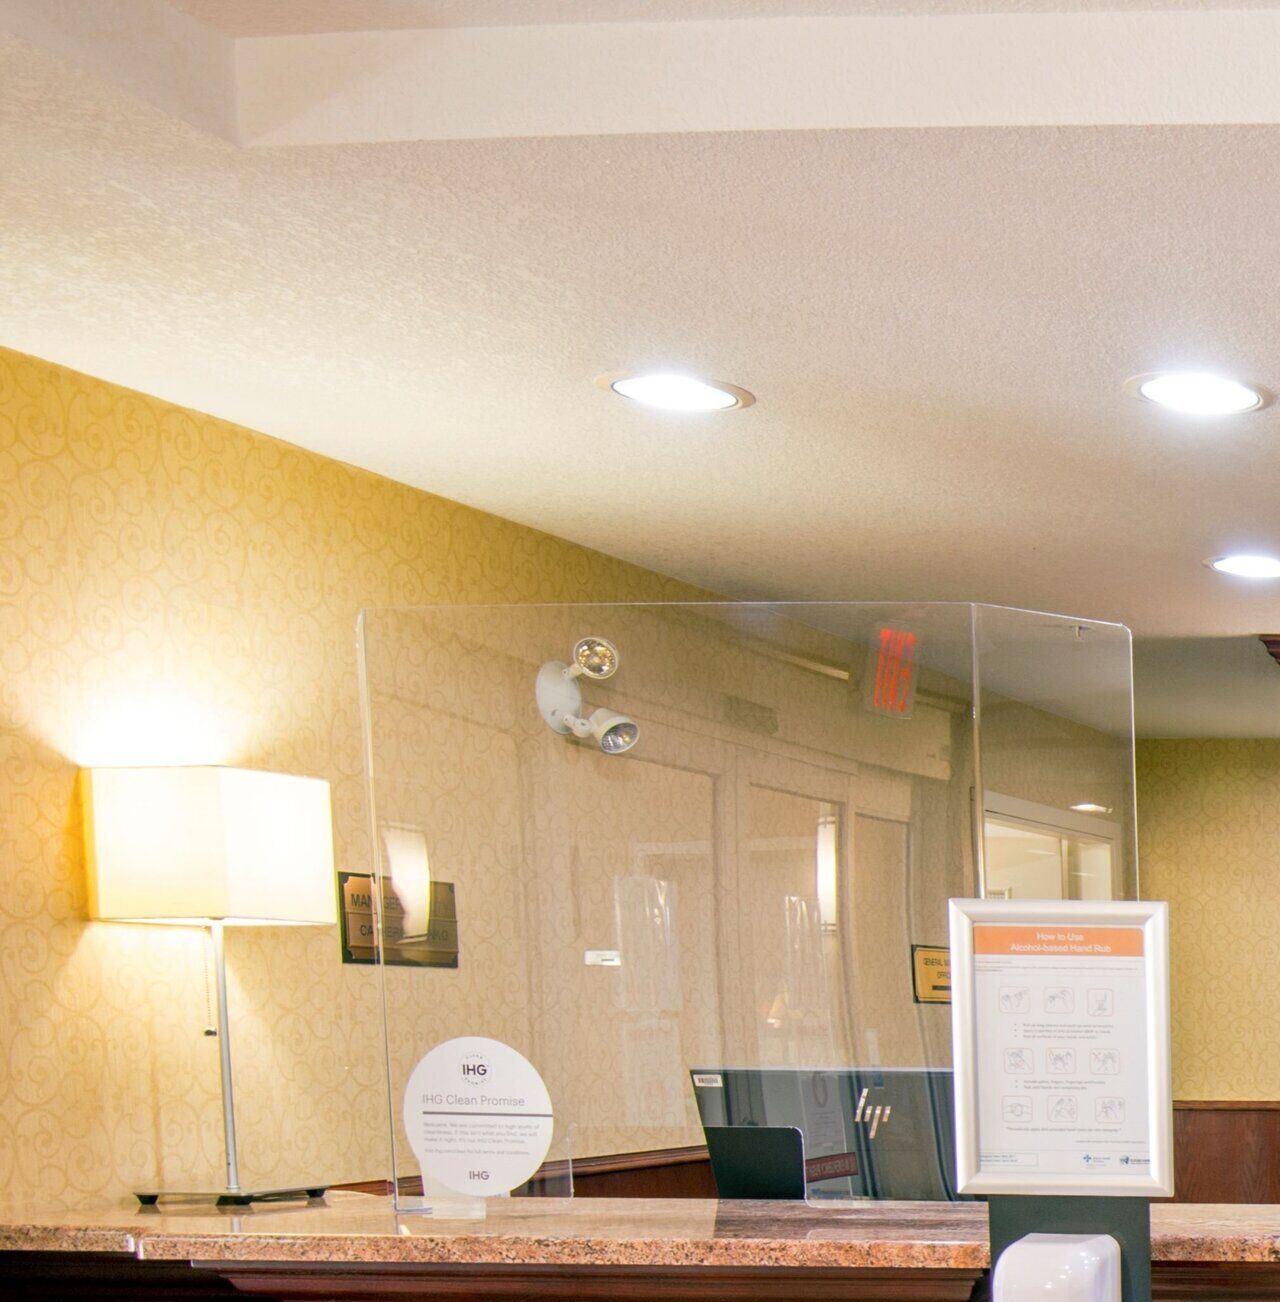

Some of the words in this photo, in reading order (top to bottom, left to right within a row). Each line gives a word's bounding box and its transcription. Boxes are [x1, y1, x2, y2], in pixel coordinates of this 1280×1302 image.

[1037, 931, 1056, 940] How
[1067, 932, 1084, 941] Use
[462, 1064, 487, 1076] IHG
[422, 1094, 443, 1104] IHG
[446, 1094, 477, 1106] Clean
[480, 1095, 525, 1107] Promise
[469, 1170, 489, 1180] IHG
